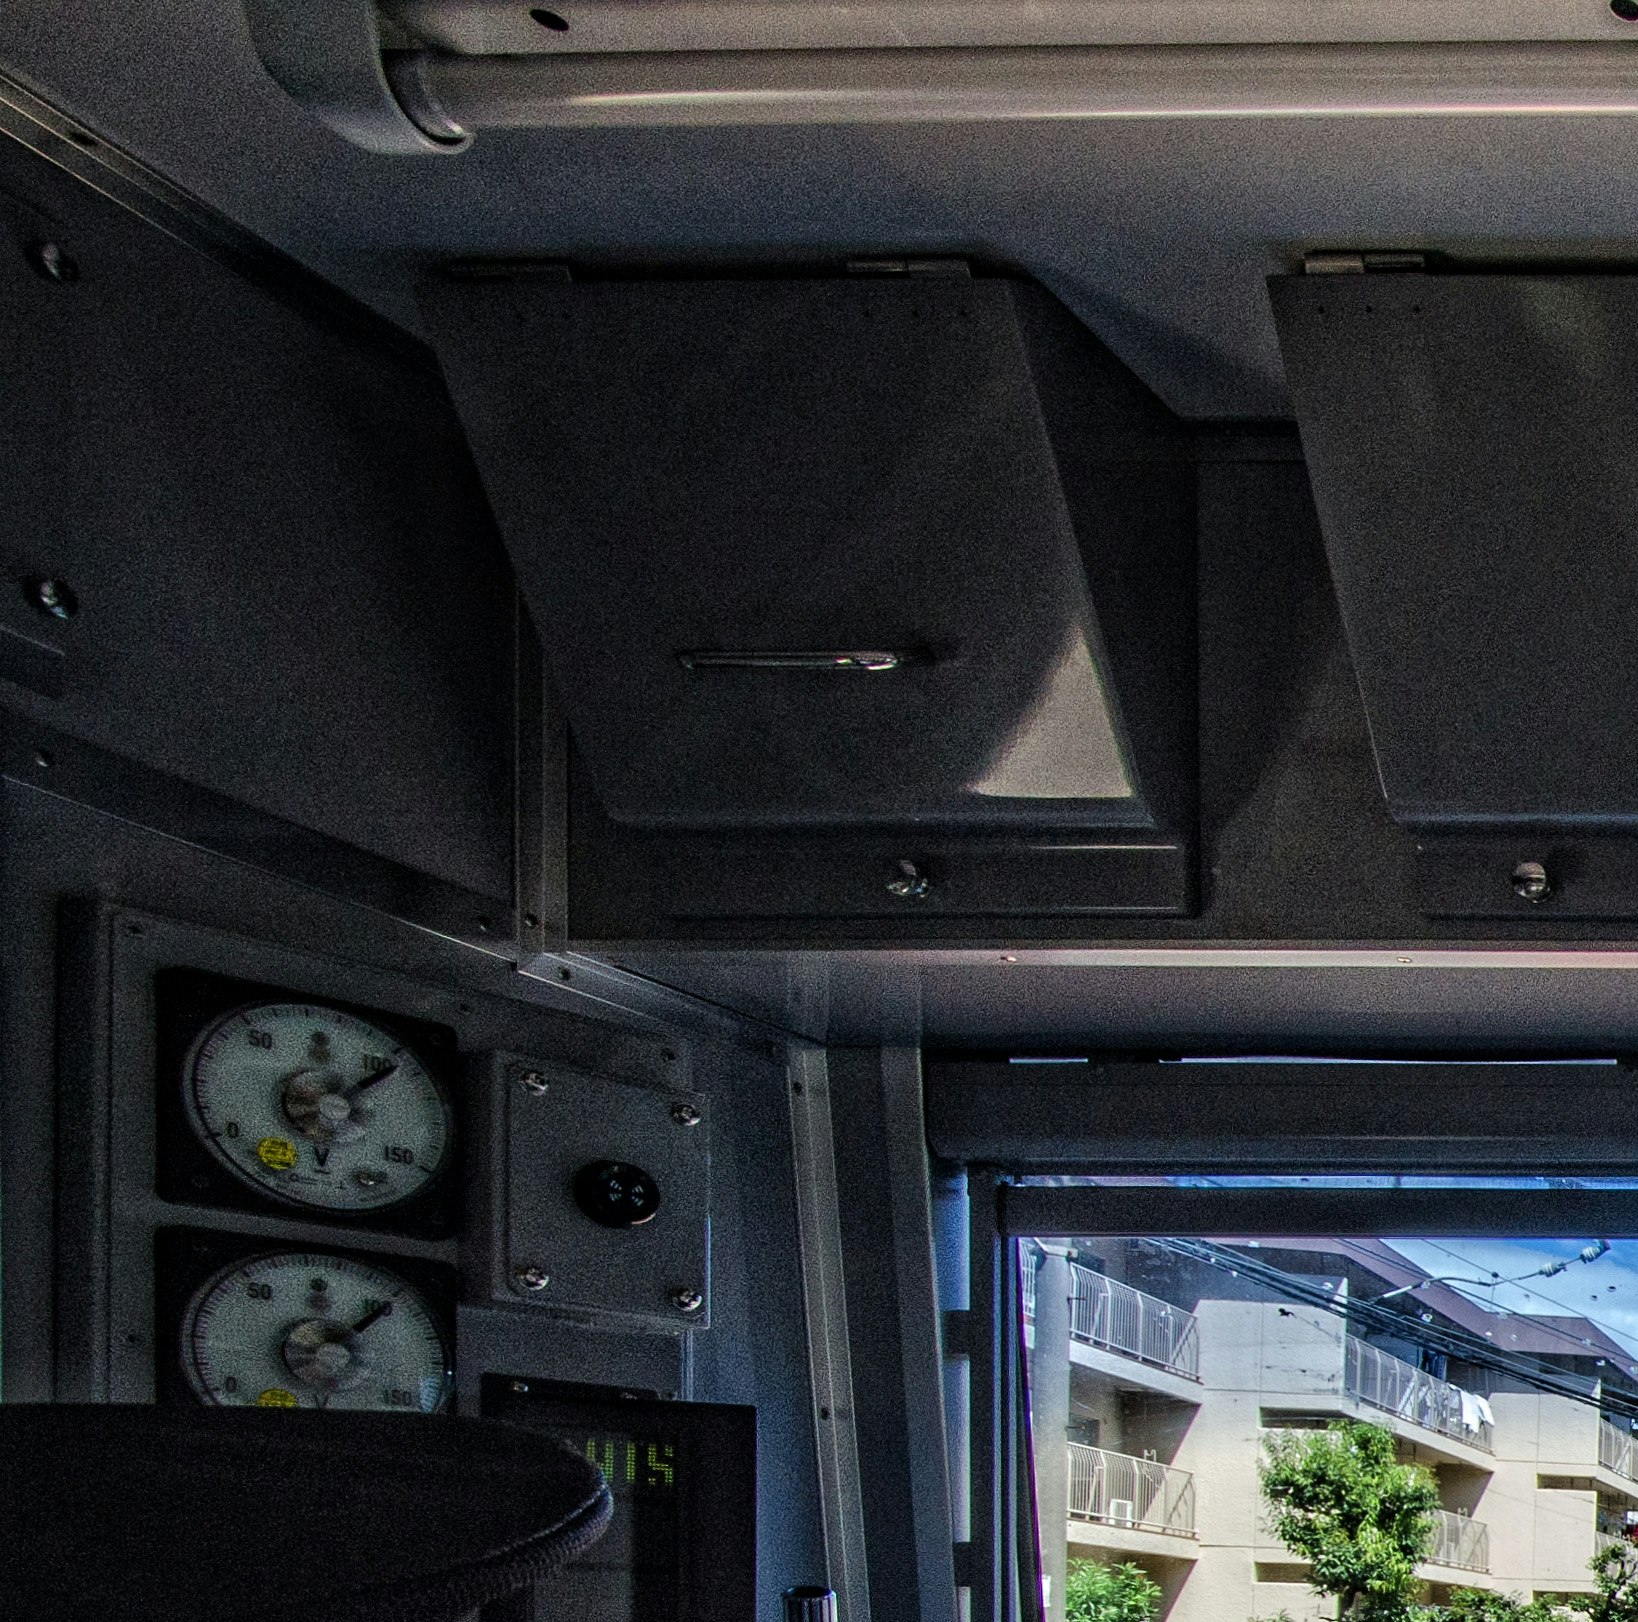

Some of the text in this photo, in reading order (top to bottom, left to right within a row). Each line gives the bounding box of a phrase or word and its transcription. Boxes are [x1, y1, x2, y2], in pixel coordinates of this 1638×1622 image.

[249, 1029, 272, 1050] 50
[363, 1054, 393, 1072] 100
[227, 1122, 238, 1138] 0
[385, 1146, 414, 1164] 150
[248, 1283, 272, 1300] 50
[226, 1377, 237, 1392] 0
[384, 1390, 412, 1406] 150
